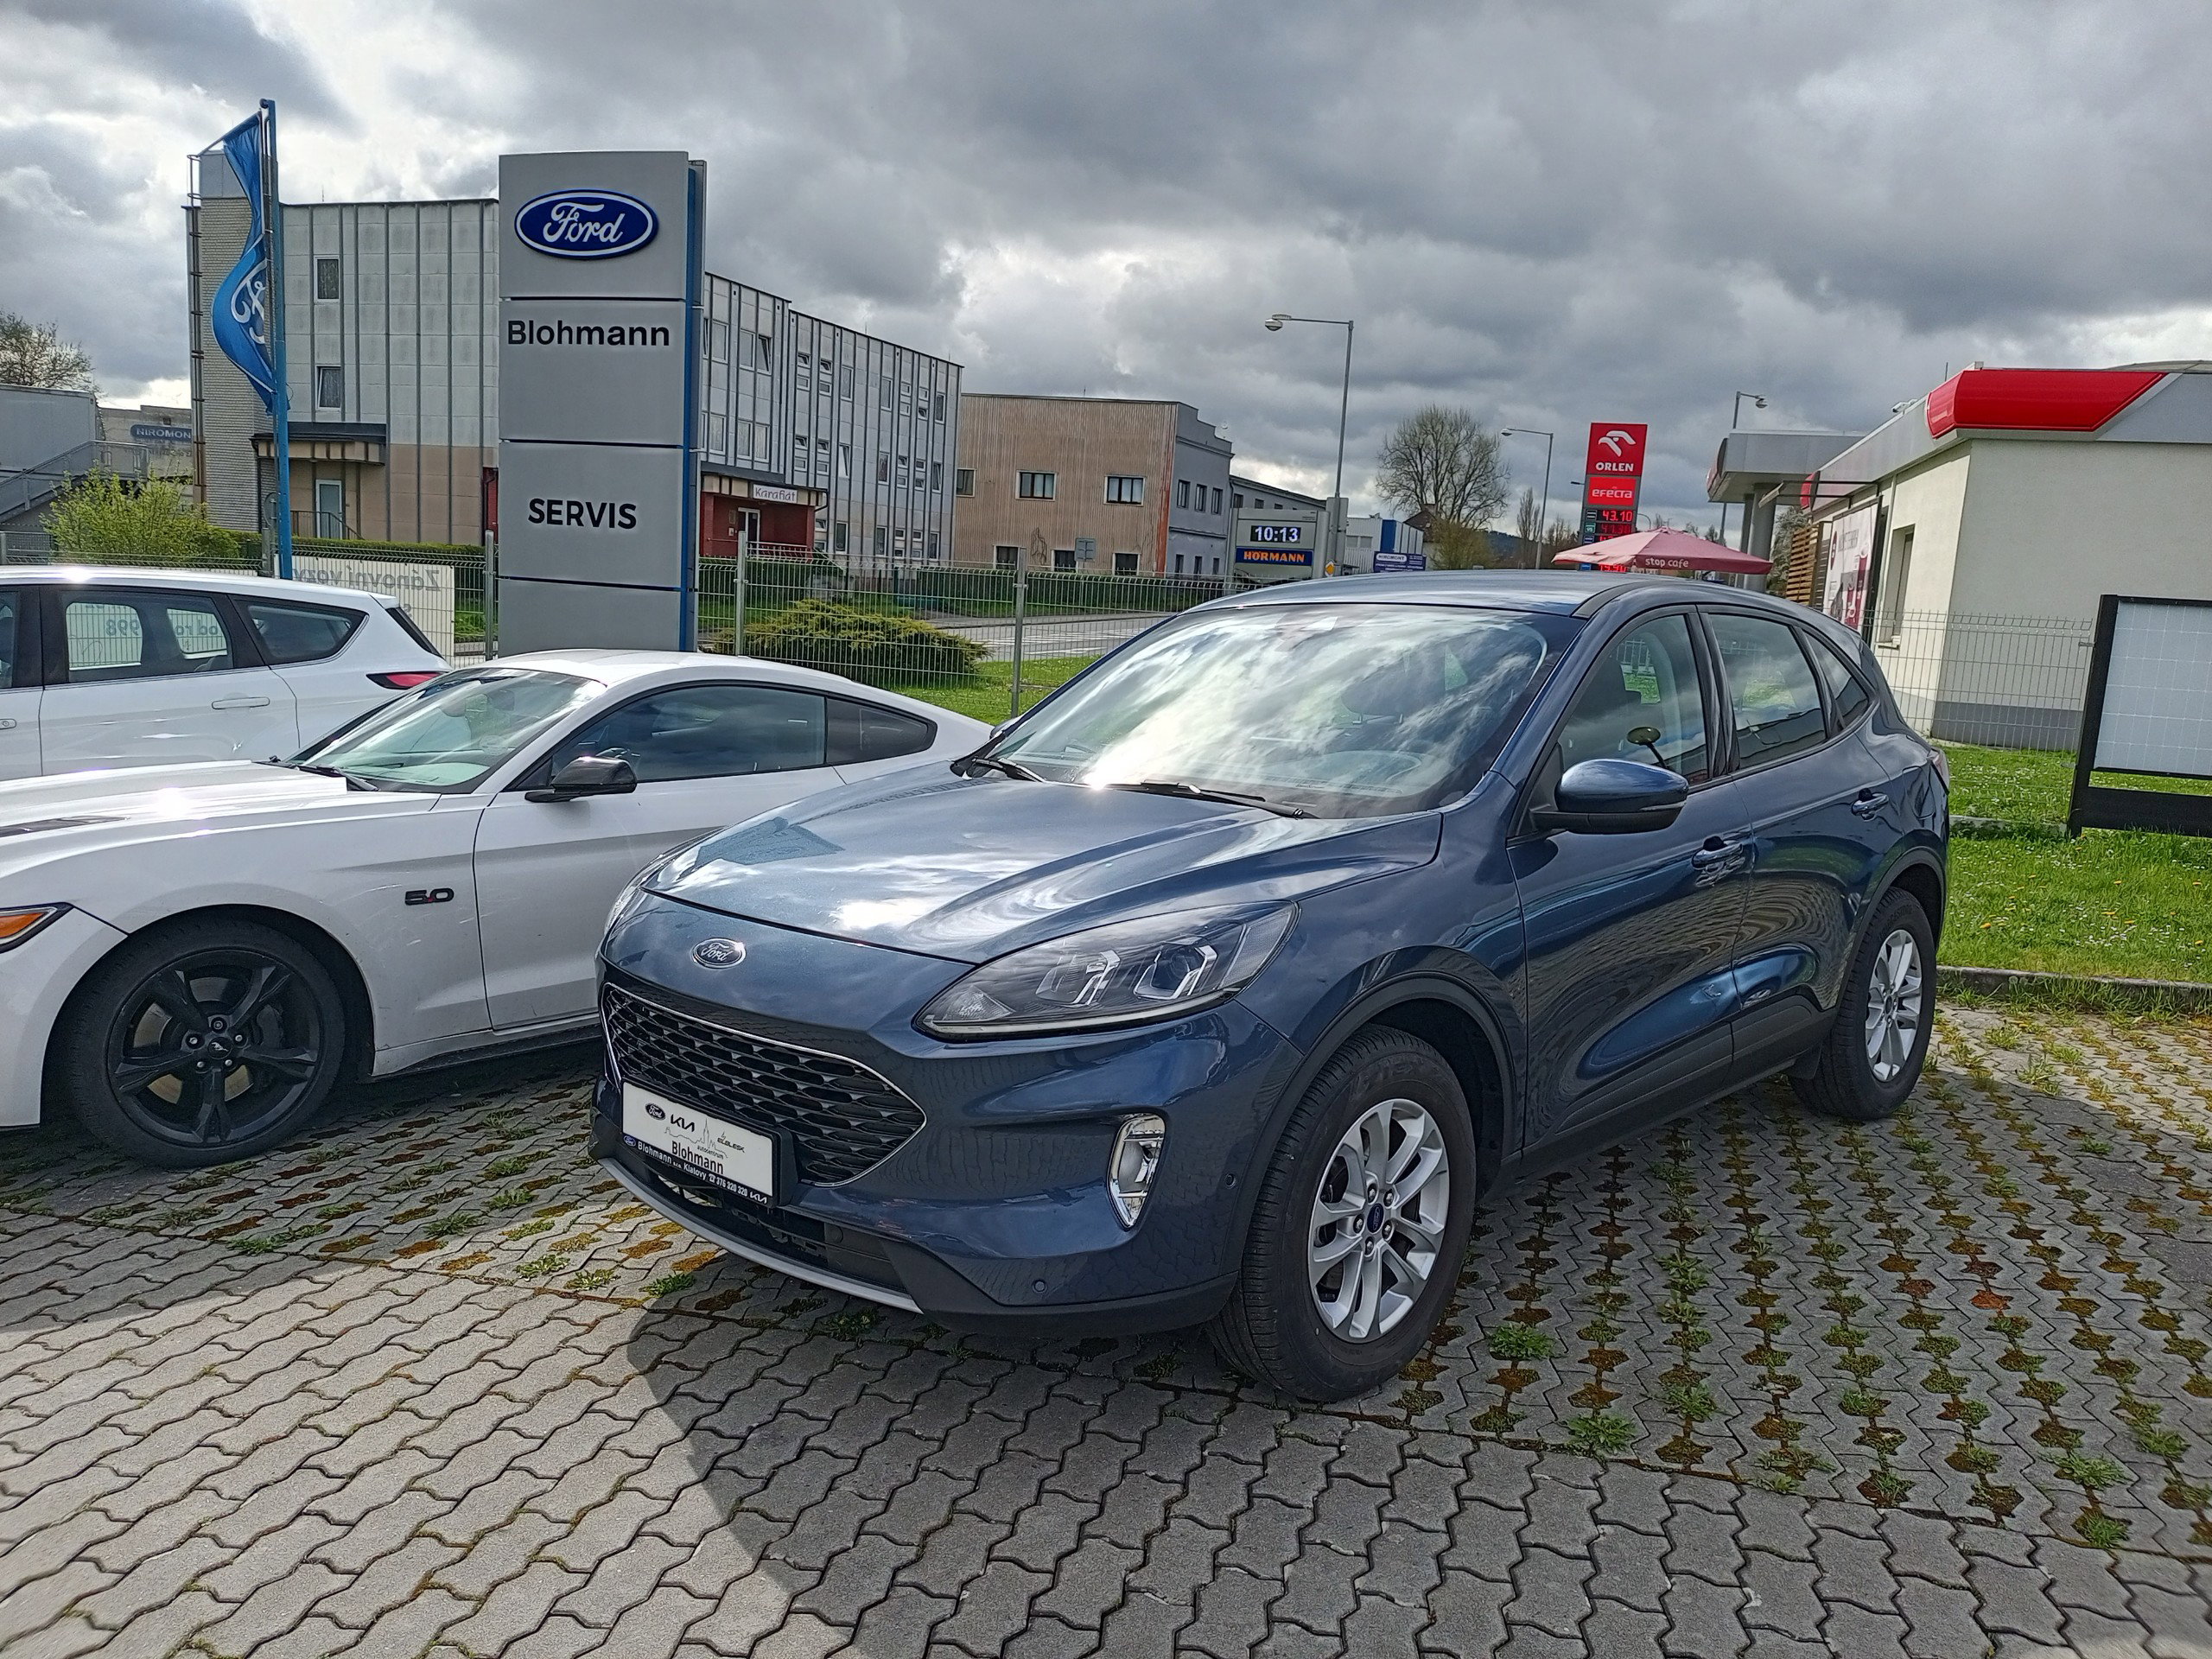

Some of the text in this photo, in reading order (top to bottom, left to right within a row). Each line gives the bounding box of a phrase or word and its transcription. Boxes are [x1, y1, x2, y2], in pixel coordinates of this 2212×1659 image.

[543, 202, 626, 243] Ford
[507, 320, 671, 346] Blohmann
[137, 428, 192, 439] NIROMON
[1595, 461, 1634, 472] ORLEN
[528, 498, 638, 530] SERVIS
[1602, 509, 1633, 522] 43.10
[1255, 526, 1299, 543] 10:13
[1243, 550, 1305, 563] HÖRMANN
[1645, 557, 1689, 569] stop cafe
[404, 887, 454, 906] 5.0
[700, 942, 734, 962] Ford
[647, 1103, 696, 1133] Ford KIA
[638, 1141, 672, 1165] Blohmann
[671, 1140, 724, 1175] Blohmann
